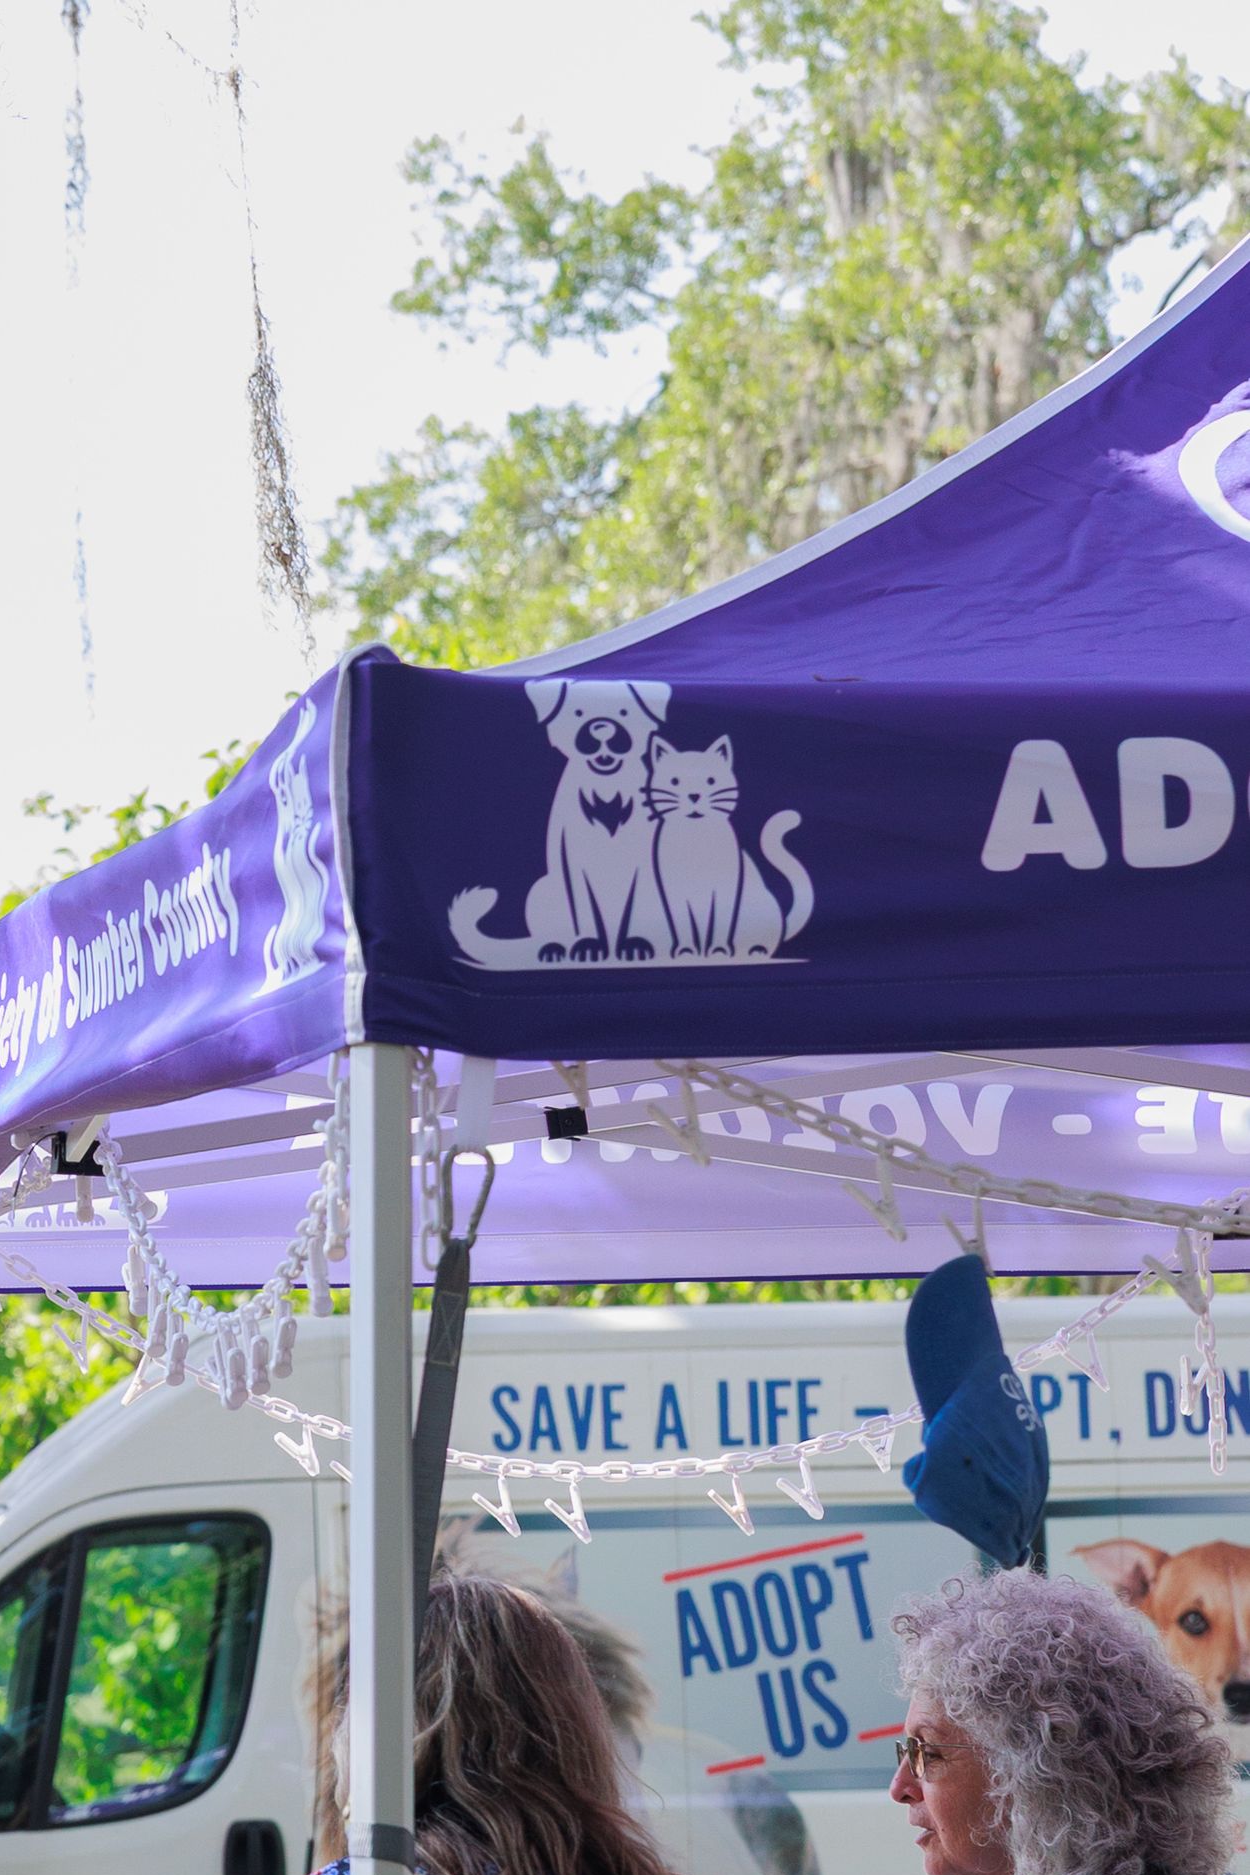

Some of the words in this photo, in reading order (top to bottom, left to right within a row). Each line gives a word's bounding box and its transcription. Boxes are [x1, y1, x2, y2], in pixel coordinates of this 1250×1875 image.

[980, 736, 1250, 872] AD
[36, 935, 63, 1045] of
[65, 909, 145, 1029] Sumter
[143, 842, 240, 976] County
[491, 1384, 629, 1452] SAVE
[654, 1383, 688, 1450] A
[718, 1378, 823, 1447] LIFE
[676, 1551, 874, 1678] ADOPT
[757, 1659, 849, 1758] US
